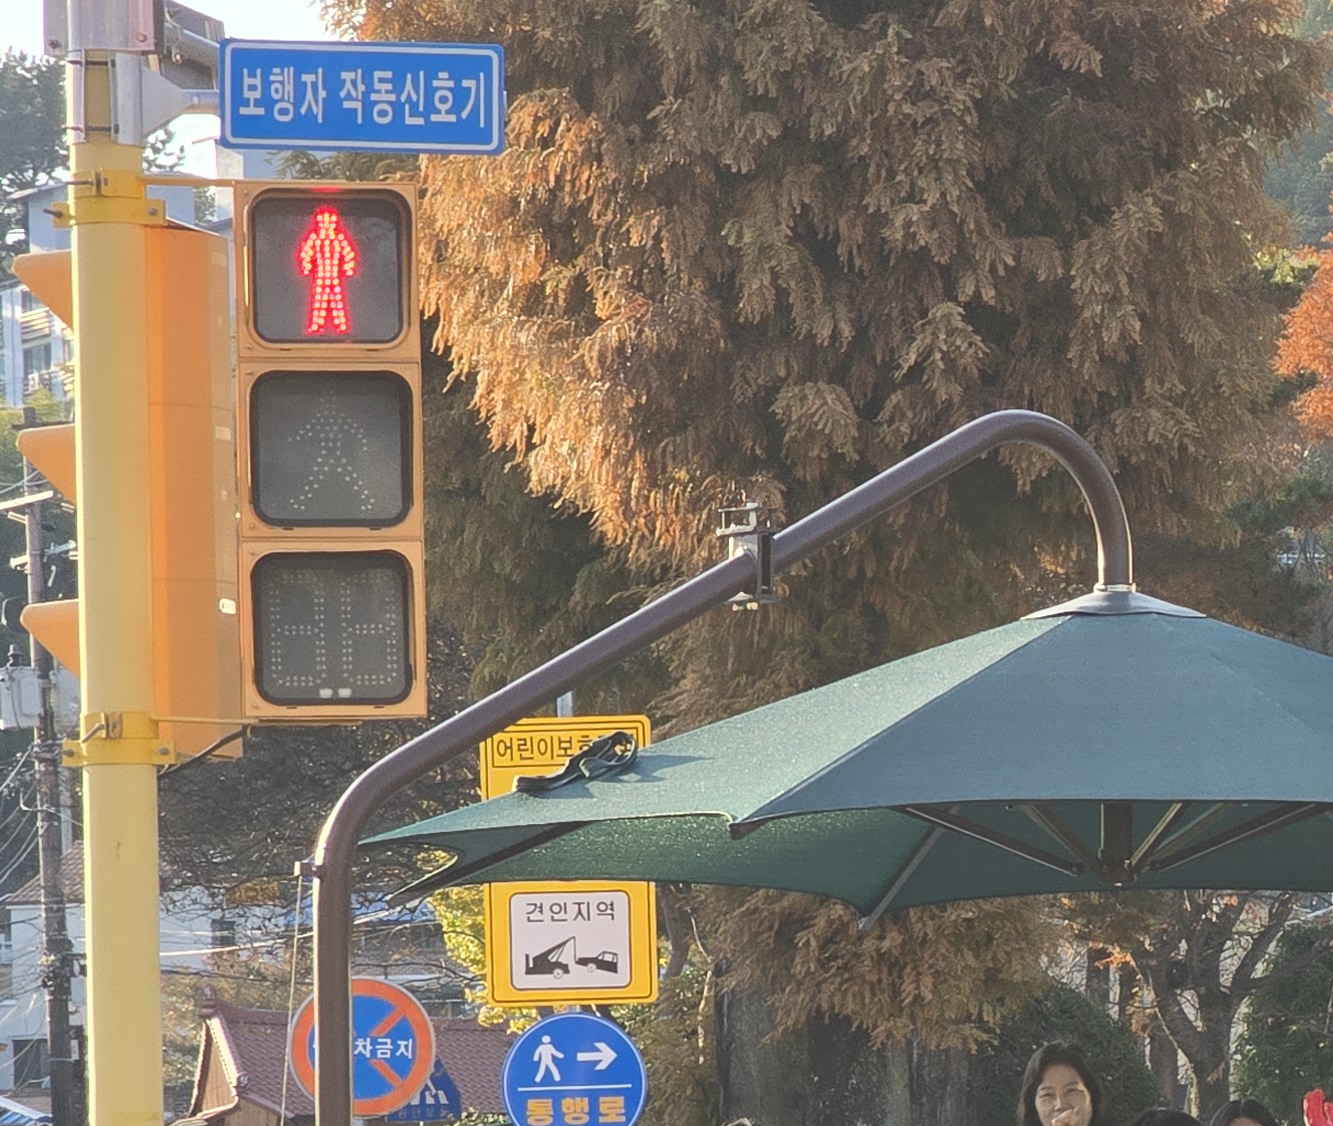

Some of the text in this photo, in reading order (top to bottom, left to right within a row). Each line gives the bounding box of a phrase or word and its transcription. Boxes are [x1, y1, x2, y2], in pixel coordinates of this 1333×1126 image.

[239, 66, 485, 128] 보행자 작동신호기
[525, 900, 615, 923] 견인지역
[526, 1096, 626, 1126] 통행로
